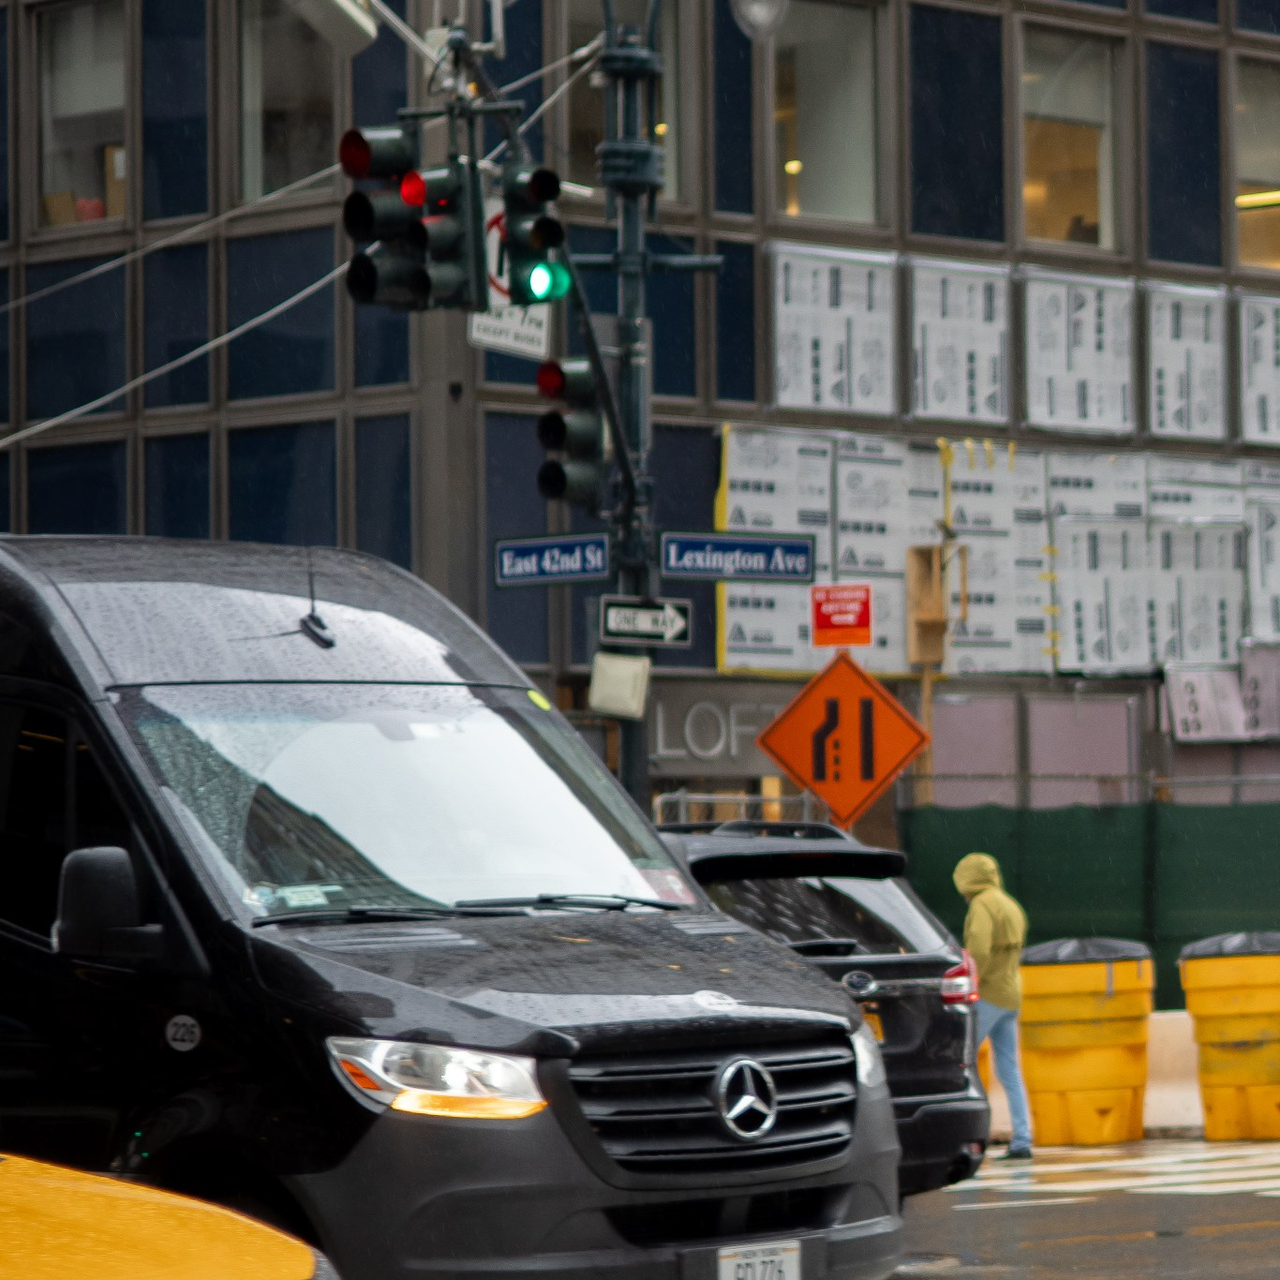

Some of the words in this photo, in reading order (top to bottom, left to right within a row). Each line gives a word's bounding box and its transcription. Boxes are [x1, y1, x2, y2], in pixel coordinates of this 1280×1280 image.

[502, 550, 537, 575] East
[541, 546, 580, 572] 42nd
[585, 542, 604, 570] St
[668, 543, 766, 575] Lexington
[770, 547, 806, 572] Ave
[614, 610, 638, 629] ONE
[651, 611, 679, 630] WAY
[171, 1021, 197, 1044] 226
